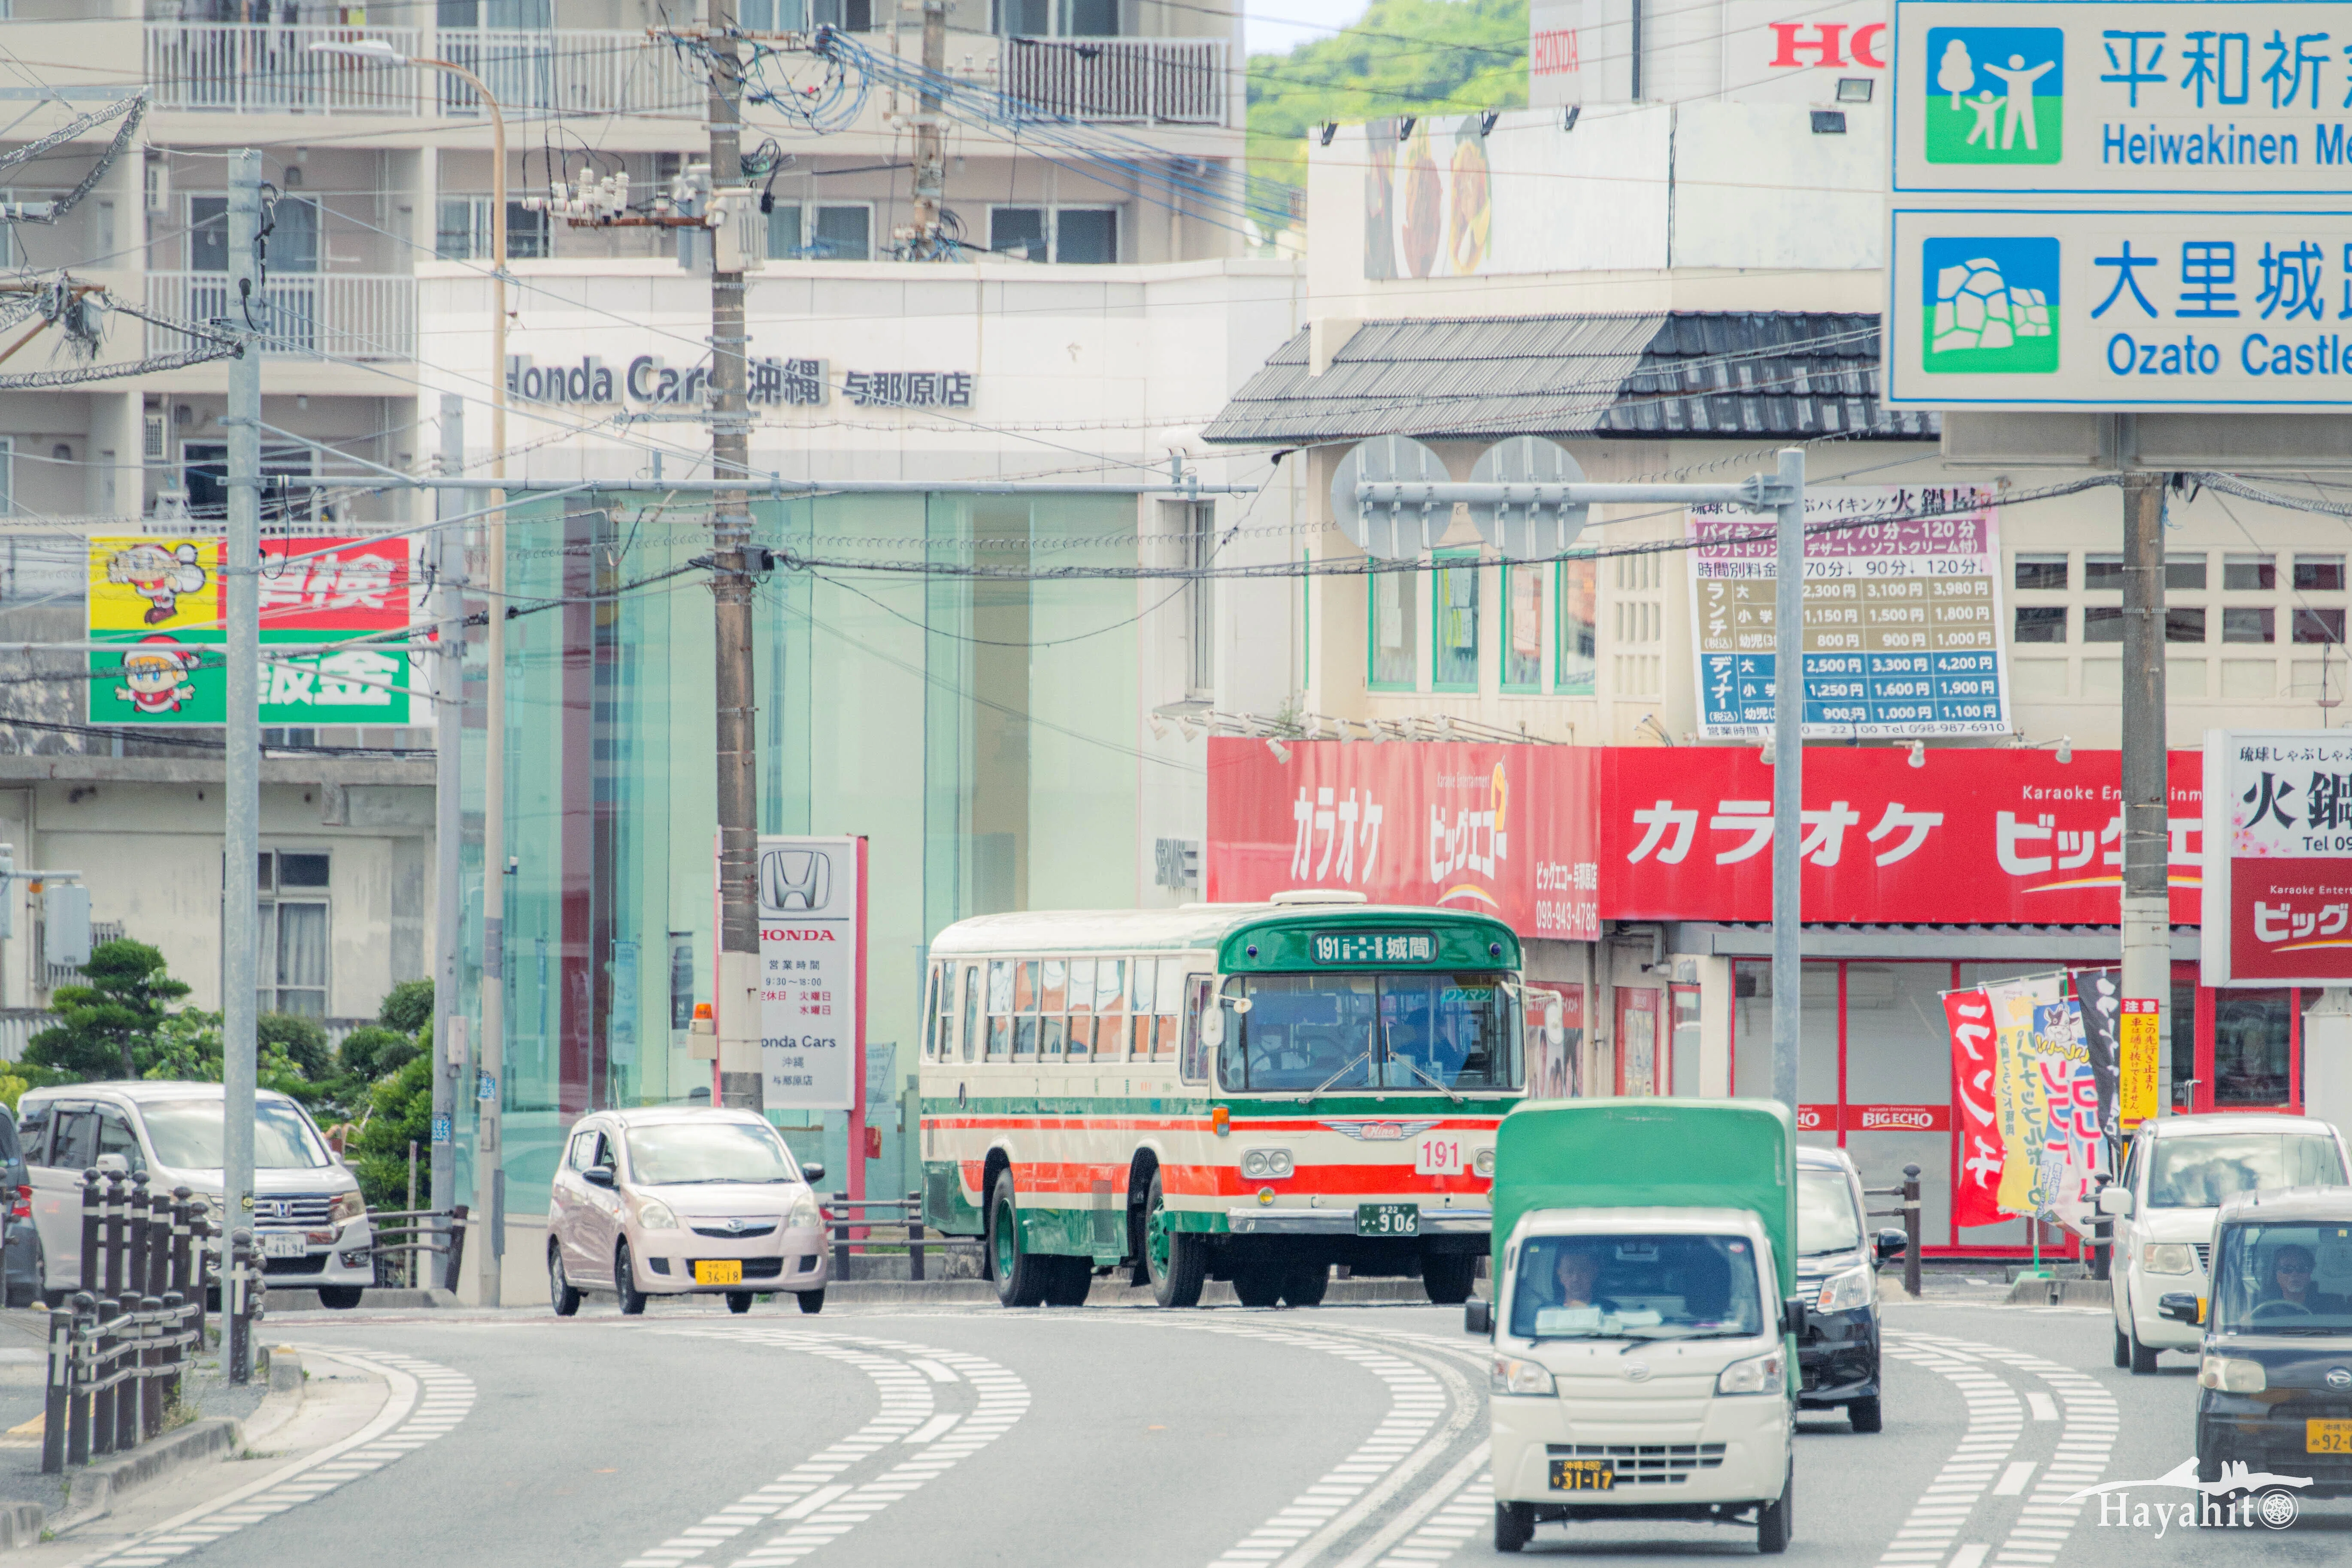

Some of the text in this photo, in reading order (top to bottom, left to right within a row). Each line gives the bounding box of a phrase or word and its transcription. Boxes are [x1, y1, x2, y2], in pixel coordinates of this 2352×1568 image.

[1535, 28, 1578, 75] HONDA
[2100, 30, 2352, 109] 平和祈
[2103, 124, 2298, 165] Heiwakinen
[2108, 333, 2220, 376] Ozato
[747, 357, 821, 404] 沖縄
[842, 370, 973, 407] 与那原店
[1698, 559, 1976, 578] 時間別料金 70分 90分 120分
[1803, 585, 1856, 599] 2,300円
[1867, 582, 1922, 597] 3,100円
[1934, 581, 1988, 596] 3,980円
[1707, 582, 1728, 637] ランチ
[1805, 610, 1858, 624] 1,150円
[1870, 607, 1924, 622] 1,500円
[1936, 606, 1990, 621] 1,800円
[1817, 633, 1859, 647] 800円
[1882, 633, 1926, 647] 900円
[1937, 631, 1991, 646] 1,000円
[1806, 658, 1861, 673] 2,500円
[1872, 658, 1928, 672] 3,300円
[1938, 655, 1993, 671] 4,200円
[1709, 656, 1733, 709] ディナー
[1809, 683, 1864, 698] 1,250円
[1875, 682, 1930, 697] 1,600円
[1941, 680, 1994, 695] 1,900円
[1877, 706, 1932, 720] 1,000円
[1943, 704, 1997, 719] 1,100円
[1883, 725, 1904, 733] Tel
[1437, 772, 1490, 789] Karaoke Entertainment
[2023, 785, 2094, 800] Karaoke
[1291, 786, 1383, 884] カラオケ
[1430, 804, 1508, 884] ビッグエコー
[2303, 836, 2328, 851] Tel
[2271, 886, 2315, 895] Karaoke
[1536, 900, 1597, 931] 098-943-4786
[1316, 937, 1339, 960] 191
[1386, 937, 1429, 959] 城間
[769, 959, 820, 970] 営業時間
[799, 991, 831, 1001] 火曜日
[1446, 989, 1491, 1001] ワンマン
[799, 1005, 831, 1015] 水曜日
[2125, 1001, 2155, 1012] 注意
[802, 1035, 836, 1047] Cars
[782, 1056, 804, 1068] 沖縄
[773, 1074, 813, 1086] 与那原店
[1369, 1125, 1394, 1137] Hino
[1423, 1140, 1458, 1168] 191
[1563, 1471, 1612, 1490] 31-17
